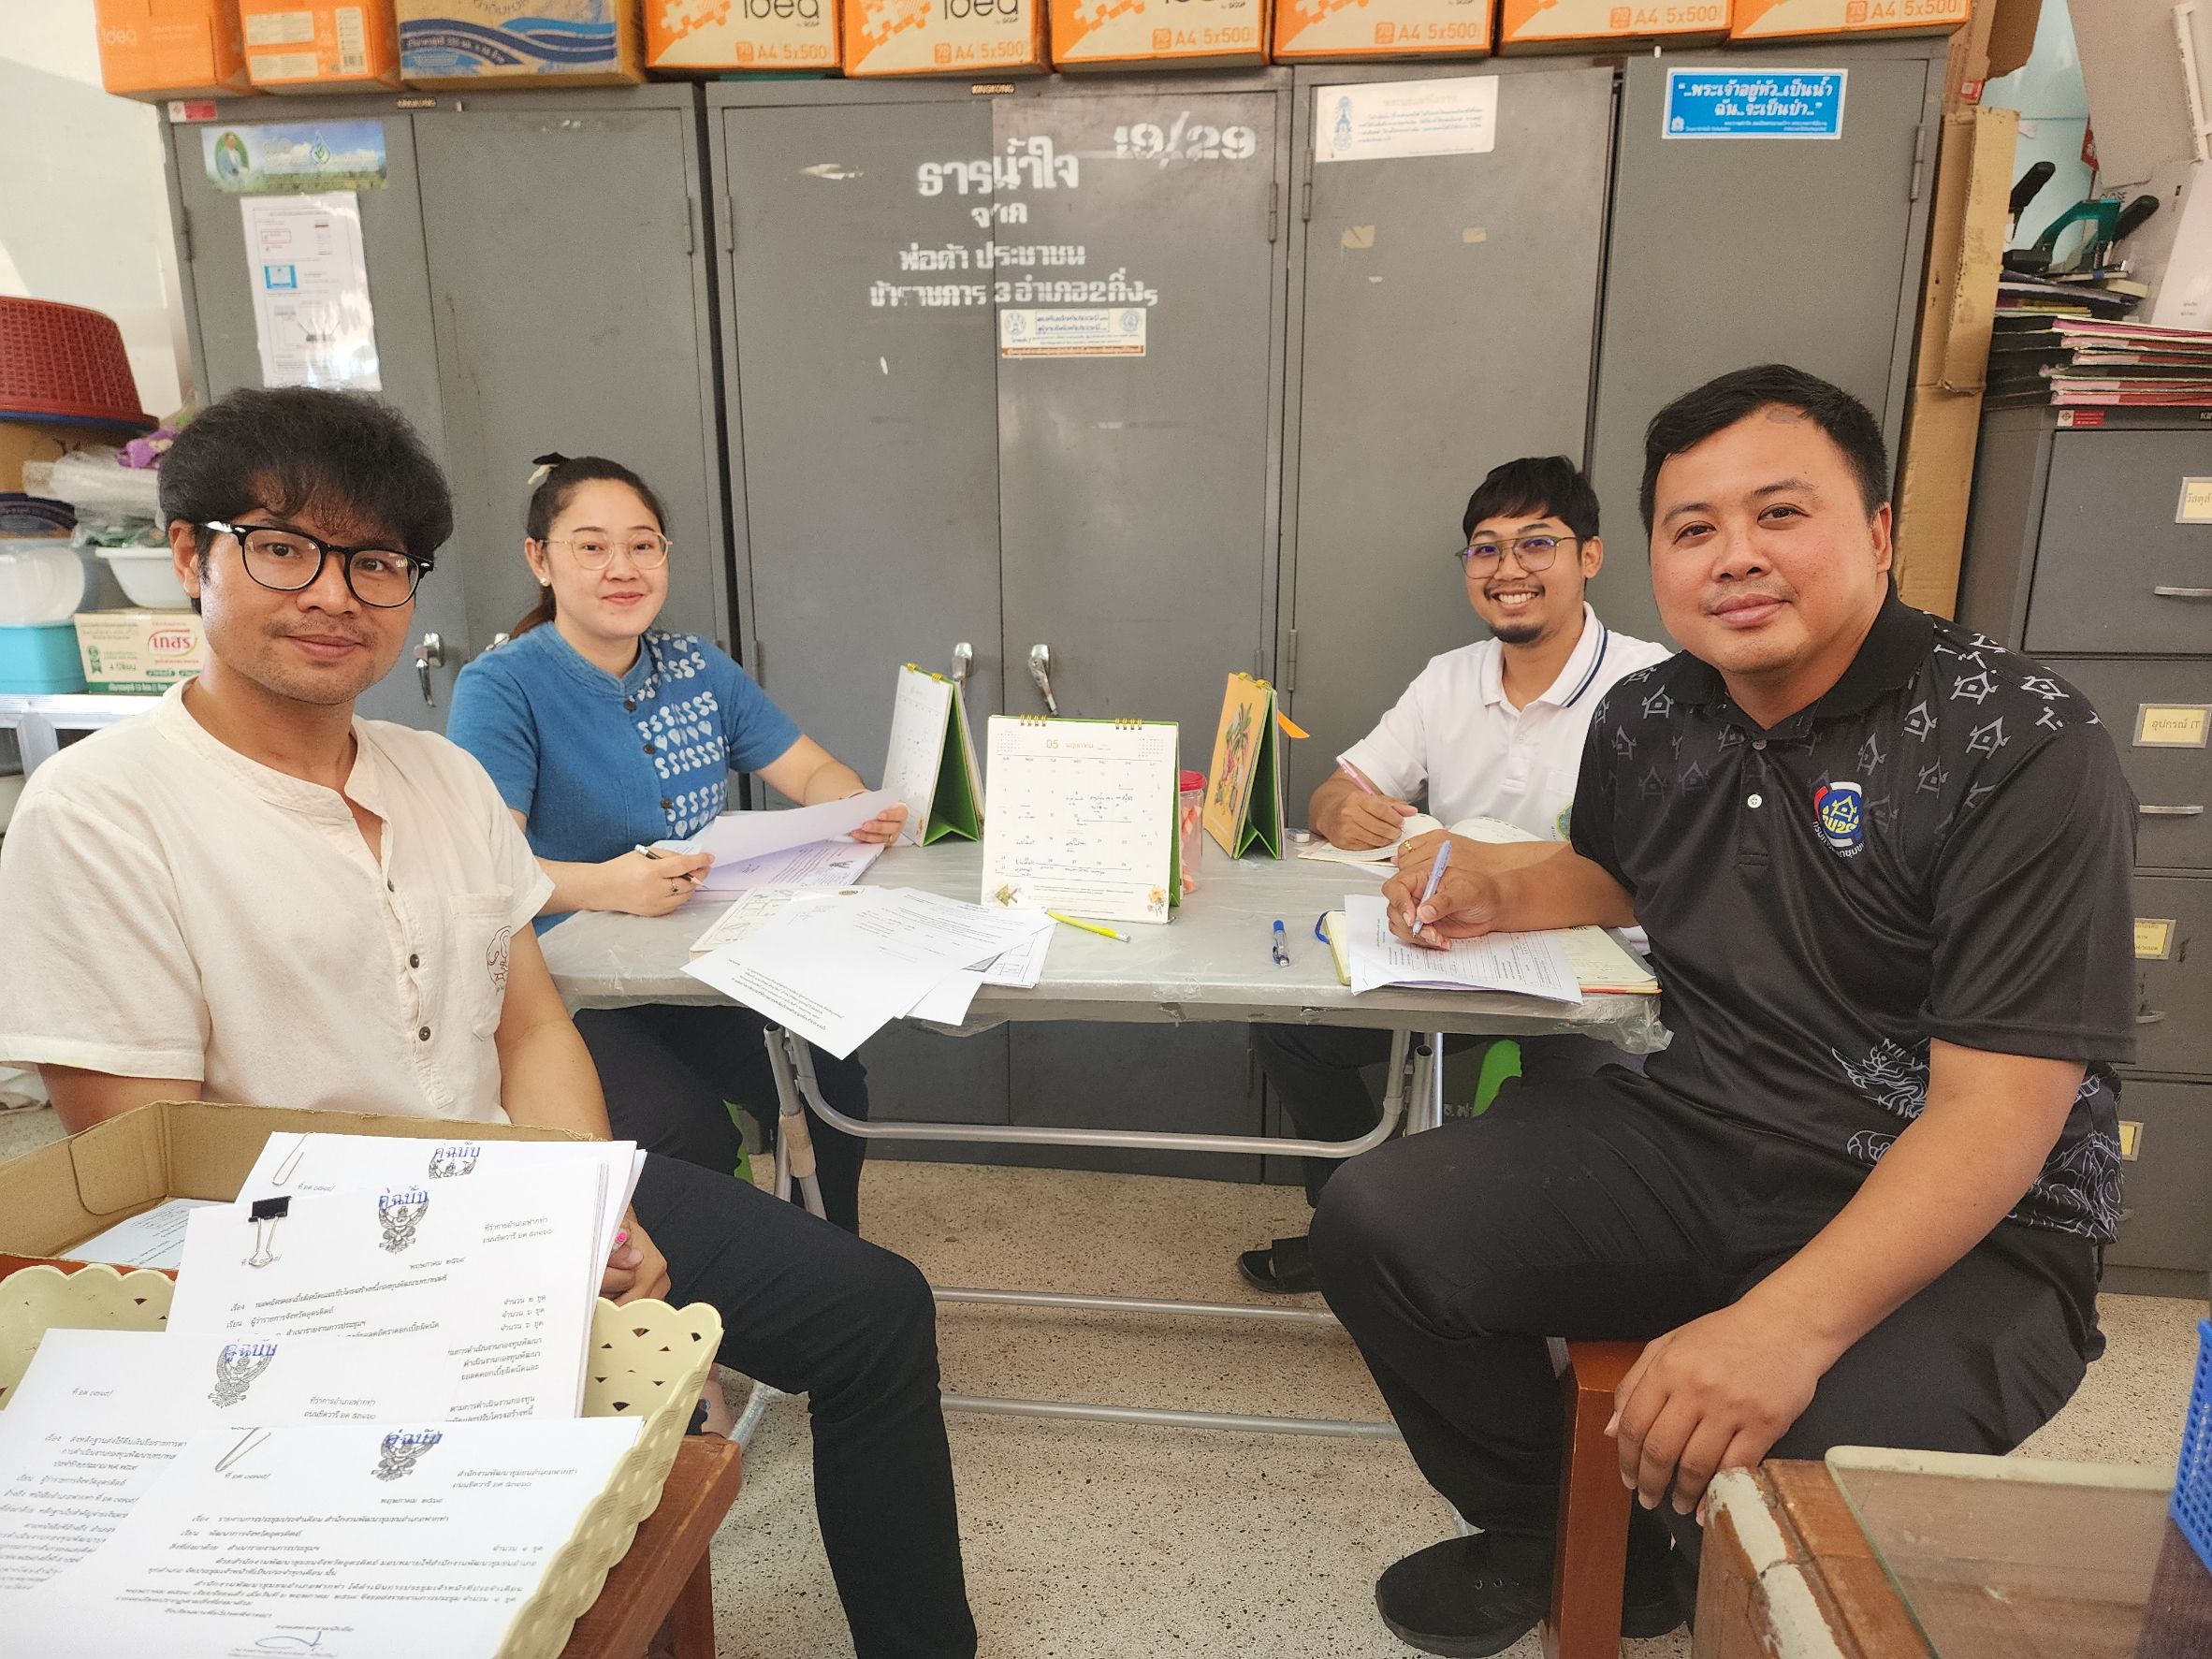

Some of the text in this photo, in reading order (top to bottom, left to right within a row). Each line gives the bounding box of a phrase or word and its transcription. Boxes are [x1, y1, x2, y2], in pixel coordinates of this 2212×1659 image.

[1635, 7, 1658, 24] A4
[1666, 6, 1718, 23] 5x500
[1870, 2, 1896, 20] A4
[1175, 30, 1197, 46] A4
[1203, 26, 1251, 45] 5x500
[1399, 23, 1420, 40] A4
[1428, 22, 1477, 39] 5x500
[757, 44, 827, 60] A4 5x500
[955, 40, 1024, 60] A4 5x500
[917, 136, 1080, 196] ธารน้ำใจ
[899, 240, 1086, 271] พ่อค้า ประชาชน
[2151, 717, 2202, 732] อุปกรณ์ IT
[433, 1141, 482, 1164] คู่ฉบับ
[378, 1186, 429, 1211] คู่ฉบับ
[226, 1319, 242, 1329] เรียน
